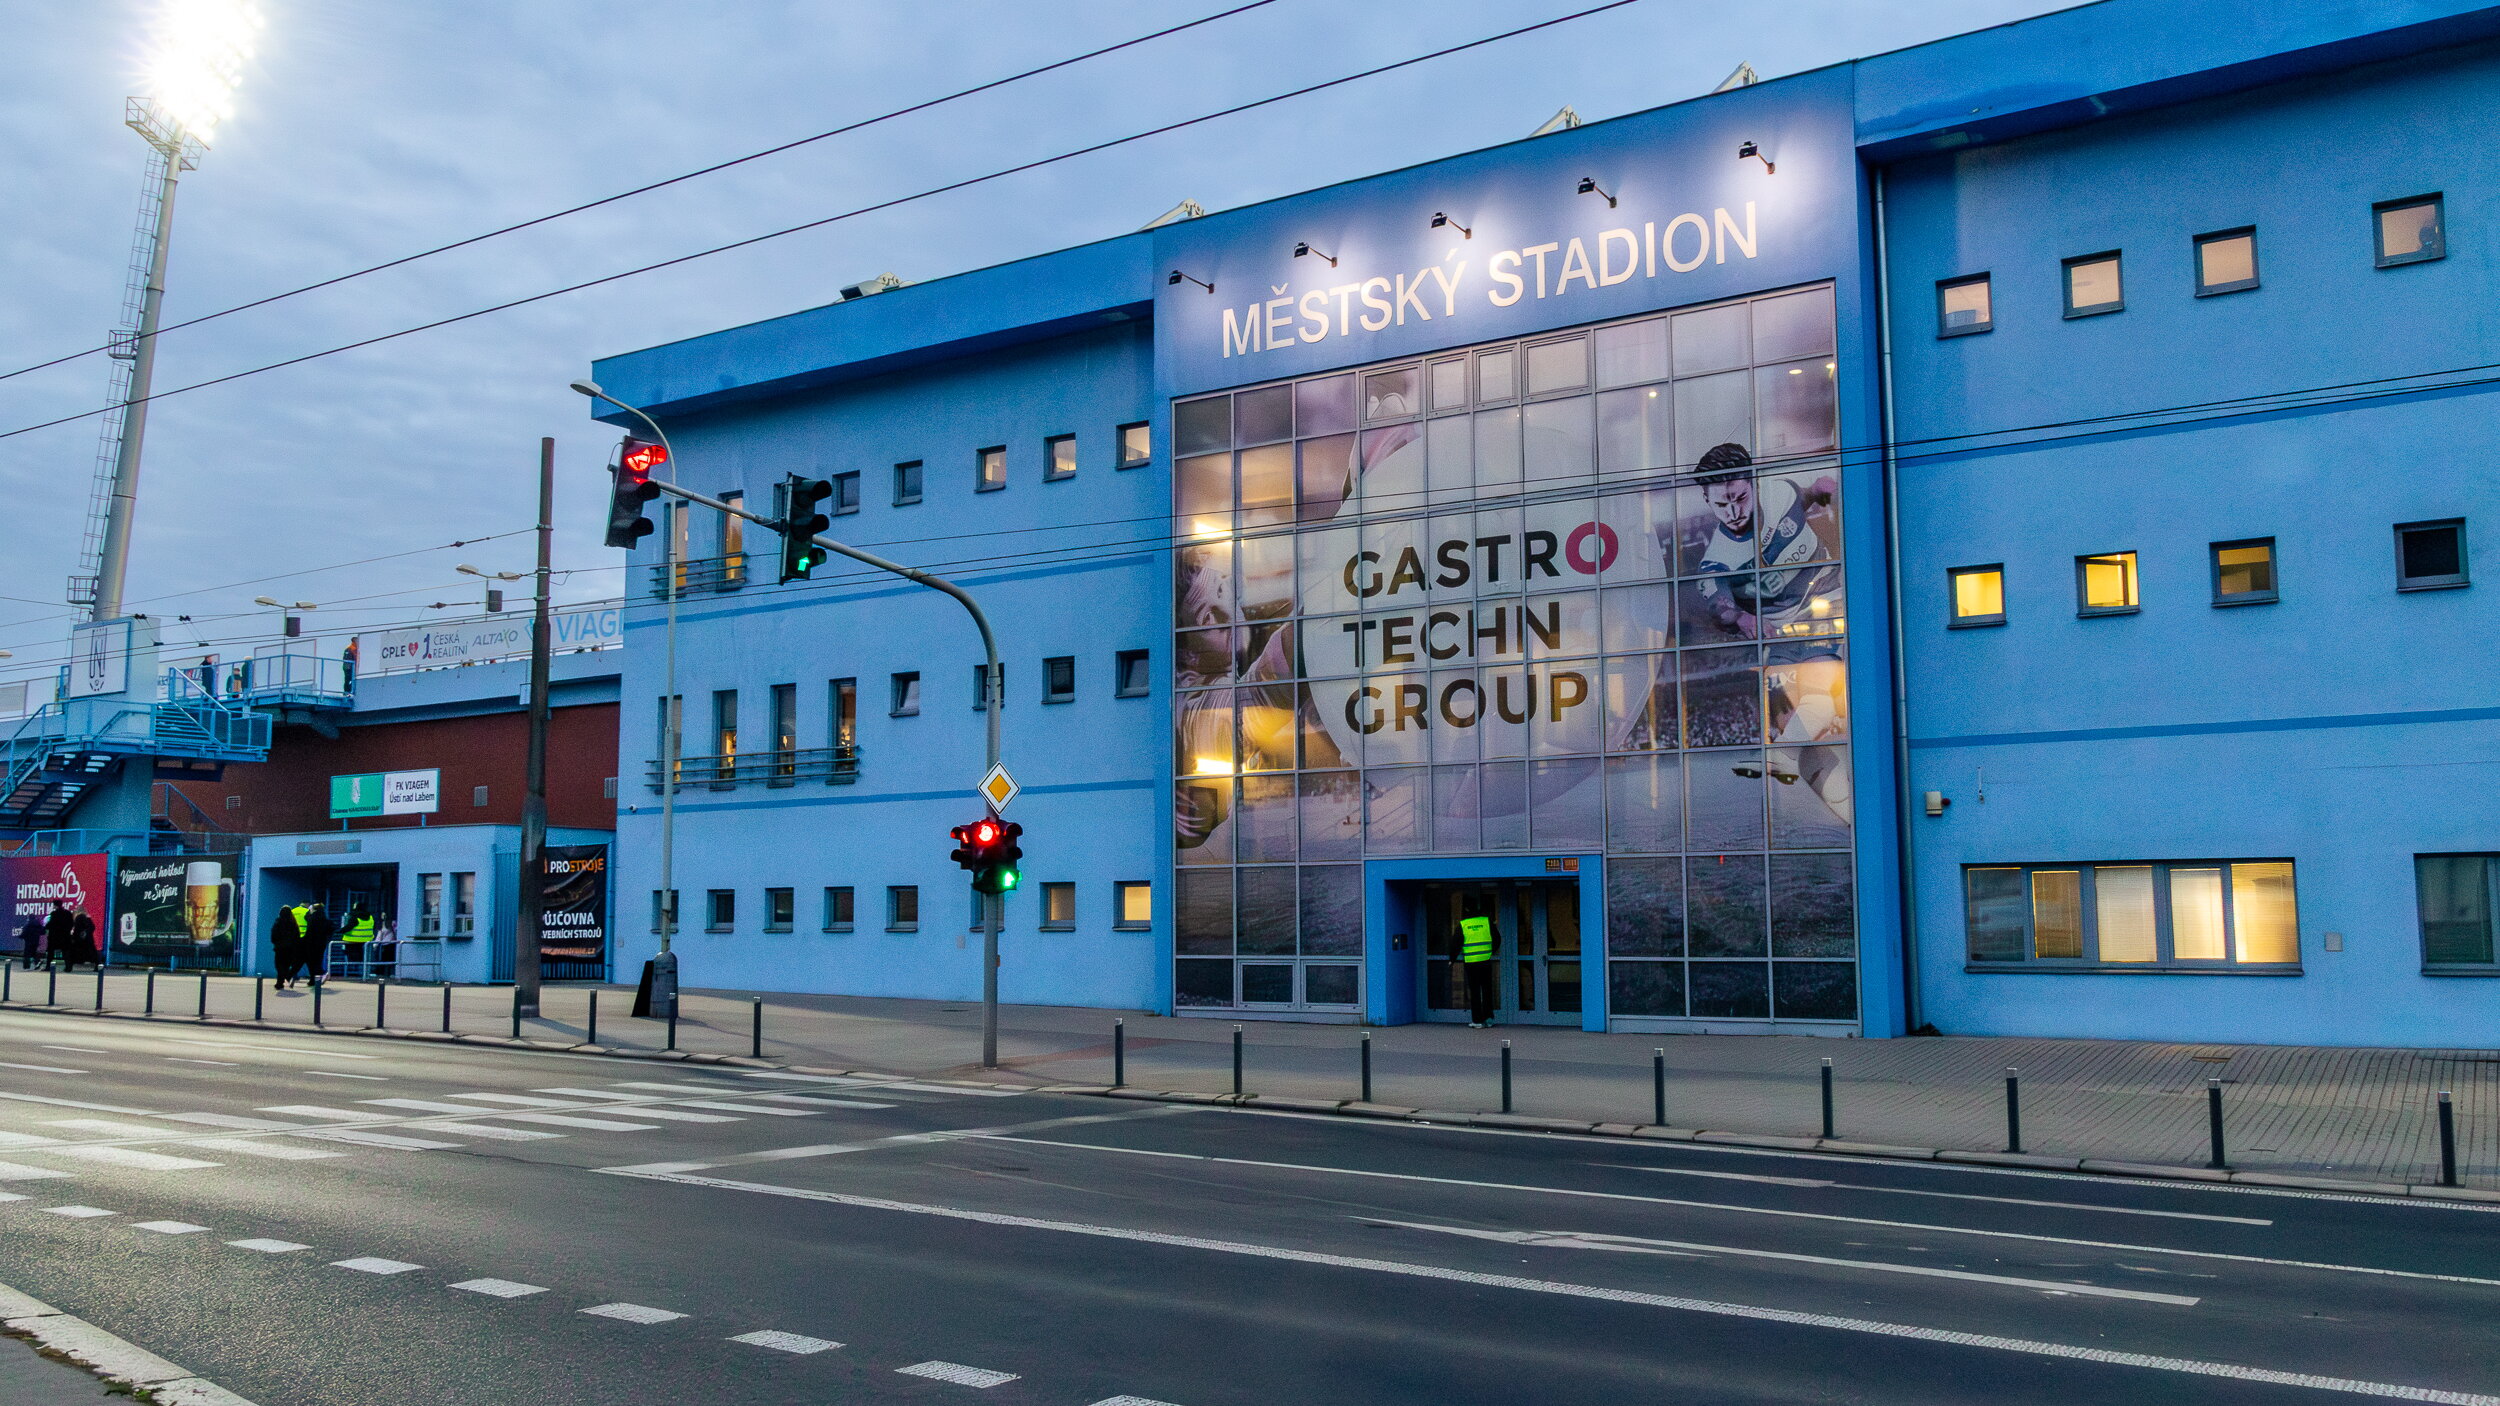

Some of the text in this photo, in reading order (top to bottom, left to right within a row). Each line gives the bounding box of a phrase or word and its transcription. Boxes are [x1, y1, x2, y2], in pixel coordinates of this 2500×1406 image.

[1222, 201, 1758, 359] MĚSTSKÝ STADION
[1342, 521, 1619, 598] GASTRO
[433, 630, 460, 646] ČESKÁ
[472, 627, 519, 648] ALTAXO
[1342, 601, 1561, 667] TECHN
[381, 645, 406, 659] CPLE
[432, 641, 468, 659] REALITNÍ
[1344, 671, 1589, 735] GROUP
[395, 780, 430, 791] FK VIAGEM
[389, 792, 435, 803] Ústí nad Labem
[549, 858, 605, 874] PROSTROJE
[16, 880, 65, 899] HITRÁDIO
[15, 902, 45, 916] NORTH
[542, 910, 595, 926] ŮJČOVNA
[573, 926, 602, 939] STROJŮ
